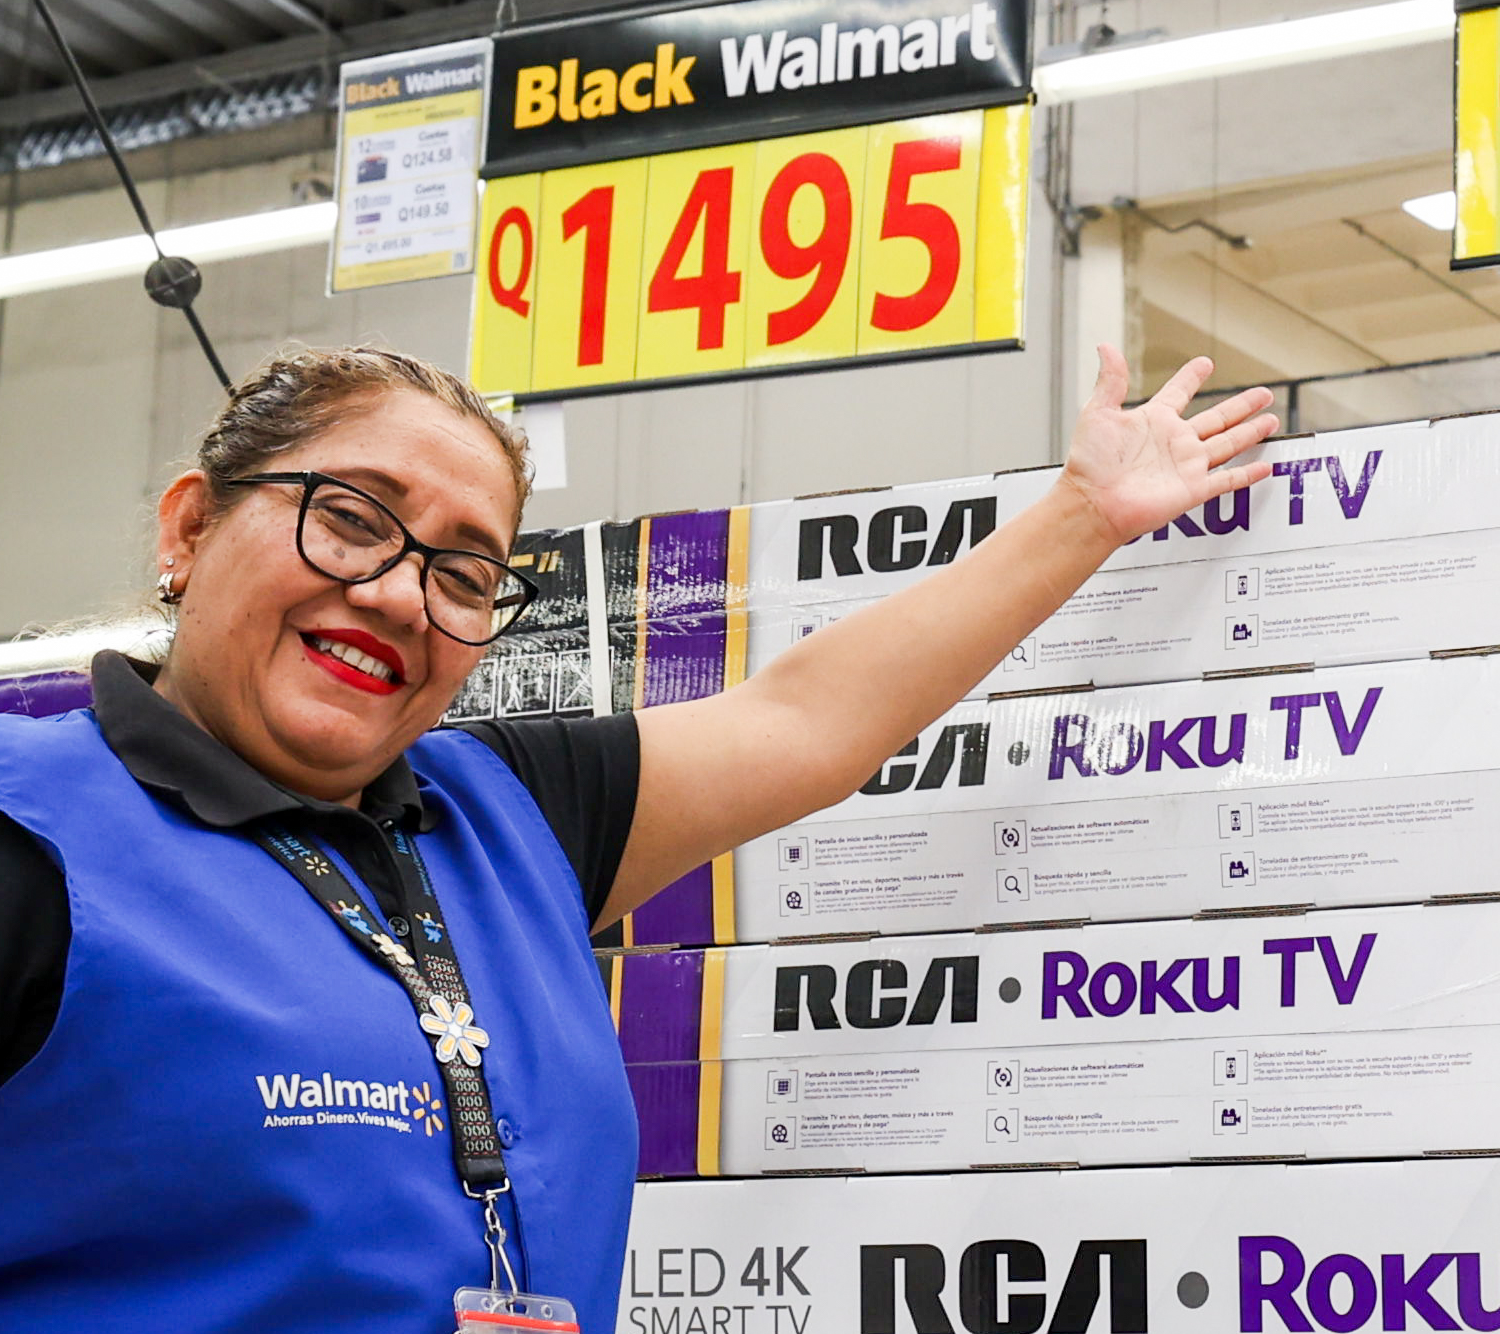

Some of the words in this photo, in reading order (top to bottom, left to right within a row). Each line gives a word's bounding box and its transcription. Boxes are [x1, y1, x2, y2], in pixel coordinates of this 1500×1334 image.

[346, 77, 399, 104] Black
[405, 65, 483, 94] Walmart
[515, 43, 696, 129] Black
[720, 3, 996, 98] Walmart
[796, 495, 998, 582] RCA
[1270, 450, 1385, 526] TV
[857, 721, 990, 797] CA
[1048, 712, 1248, 781] Roku
[1270, 686, 1385, 761] TV
[773, 956, 979, 1033] RCA
[1041, 950, 1239, 1020] Roku
[1262, 932, 1378, 1007] TV
[256, 1072, 409, 1115] Walmart
[264, 1115, 314, 1127] Ahorras
[629, 1248, 727, 1299] LED
[739, 1247, 812, 1297] 4K
